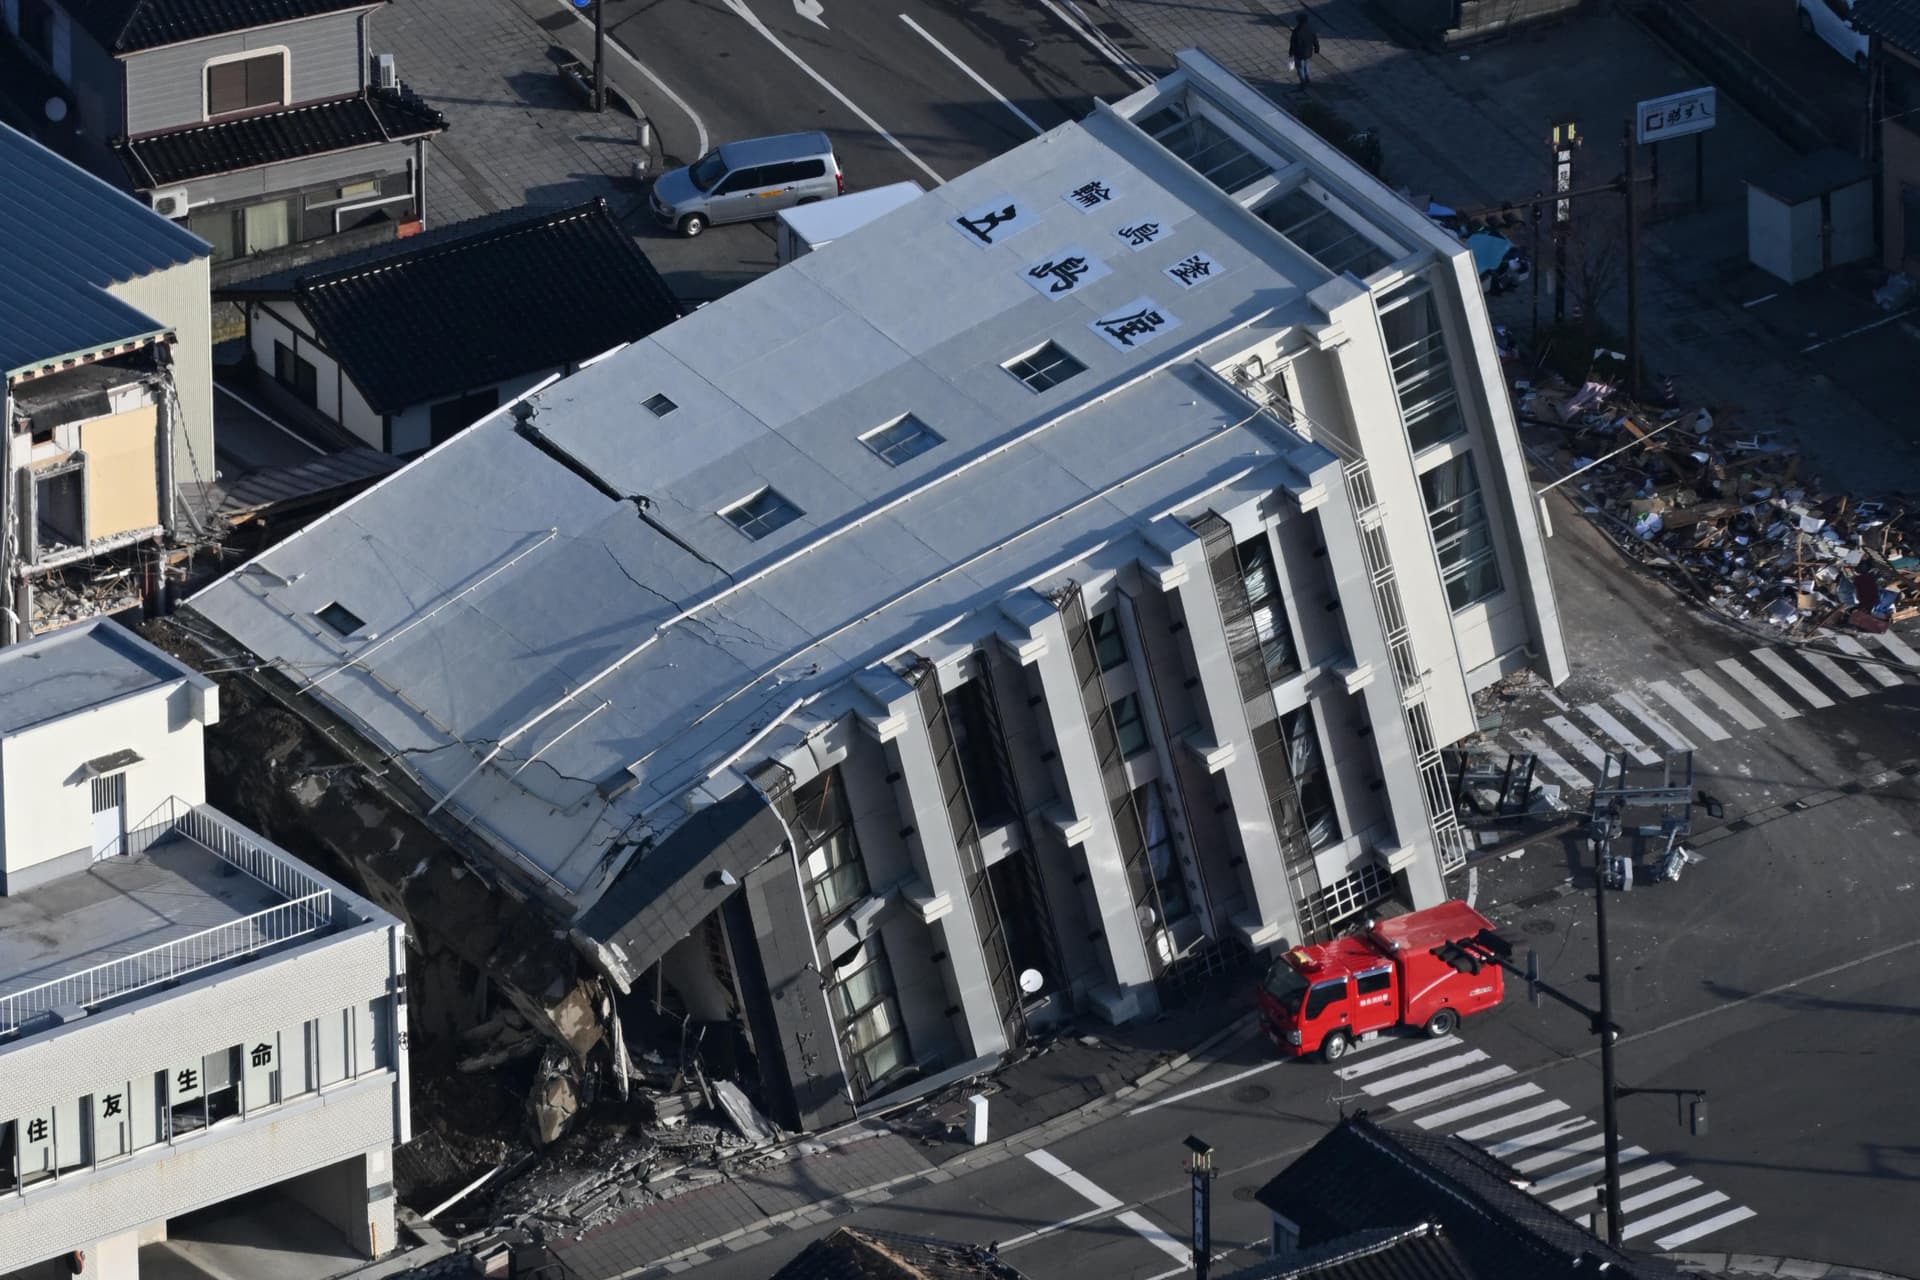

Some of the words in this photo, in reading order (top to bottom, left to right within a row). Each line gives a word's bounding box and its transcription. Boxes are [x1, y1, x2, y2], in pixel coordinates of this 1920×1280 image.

[956, 204, 1165, 346] 五島屋
[1070, 180, 1211, 286] 輪島塗
[26, 1042, 273, 1144] 住友生命
